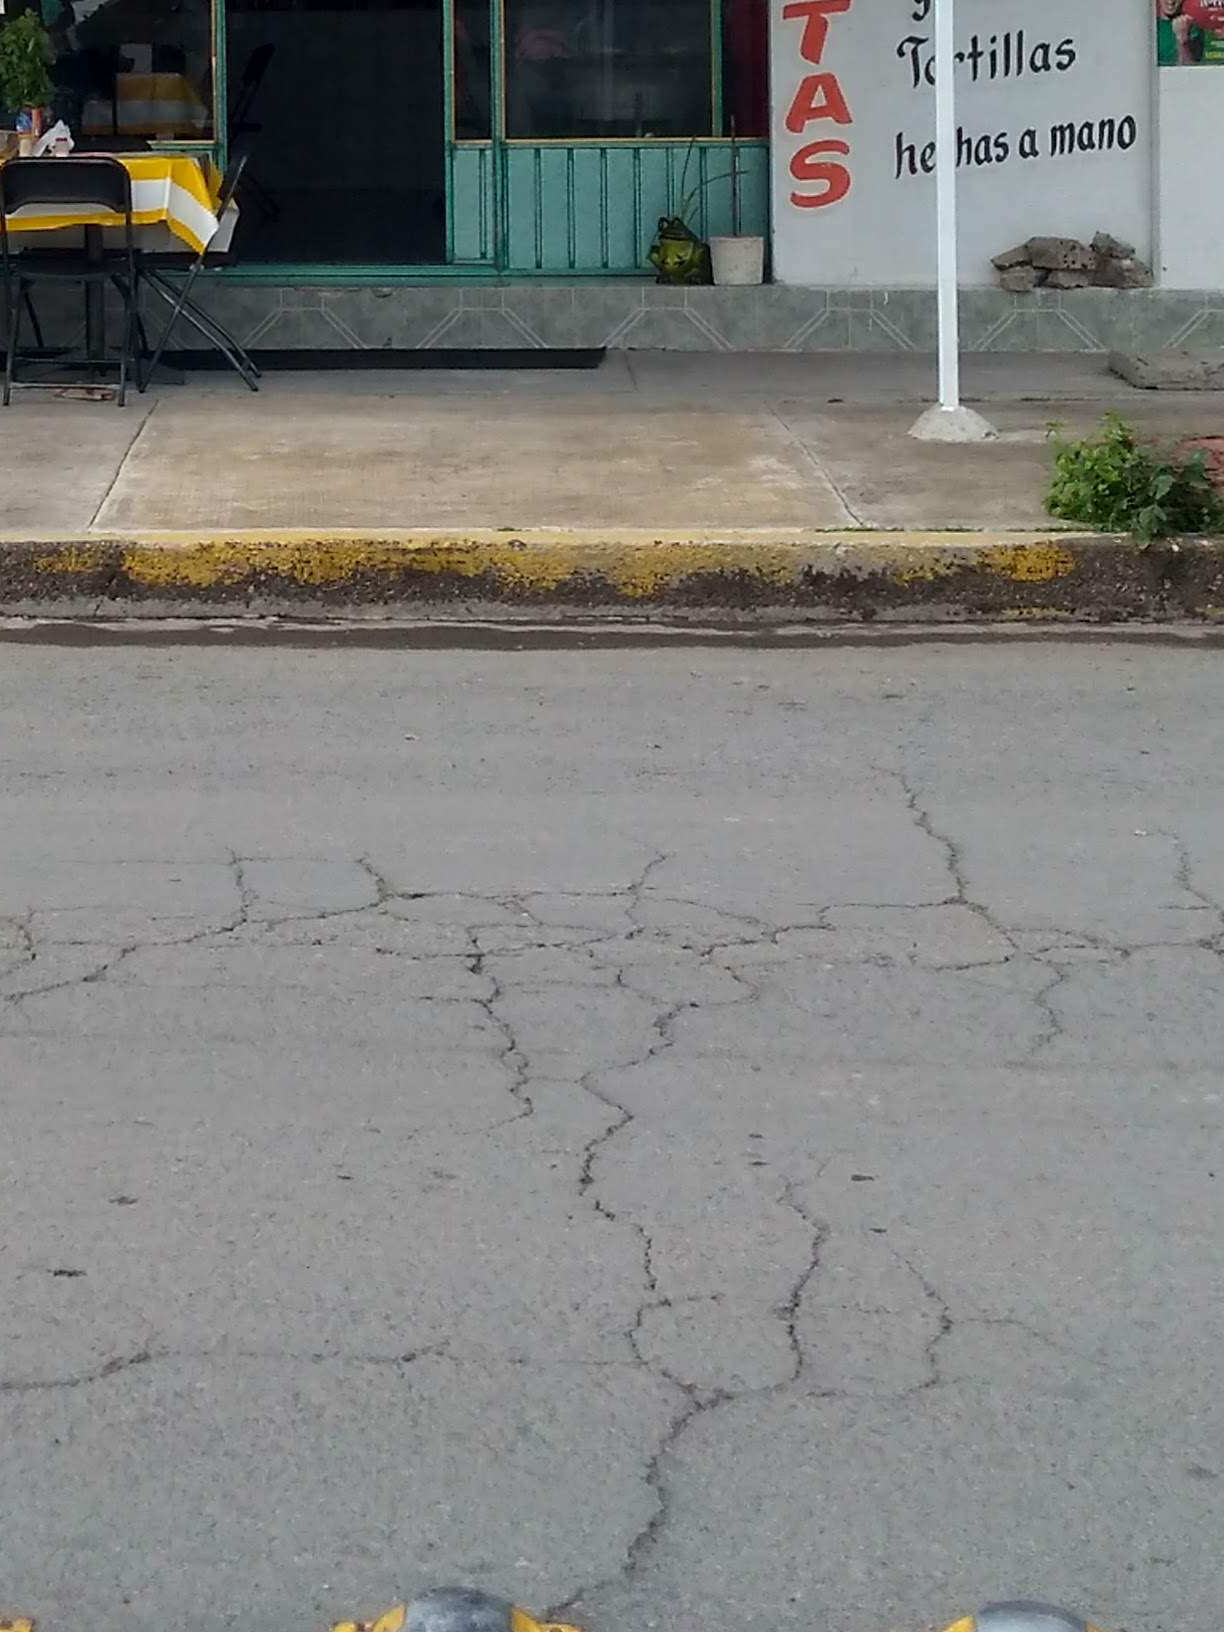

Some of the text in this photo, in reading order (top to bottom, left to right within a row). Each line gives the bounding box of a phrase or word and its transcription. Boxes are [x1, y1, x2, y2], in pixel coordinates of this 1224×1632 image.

[895, 113, 1137, 180] hehas a mano
